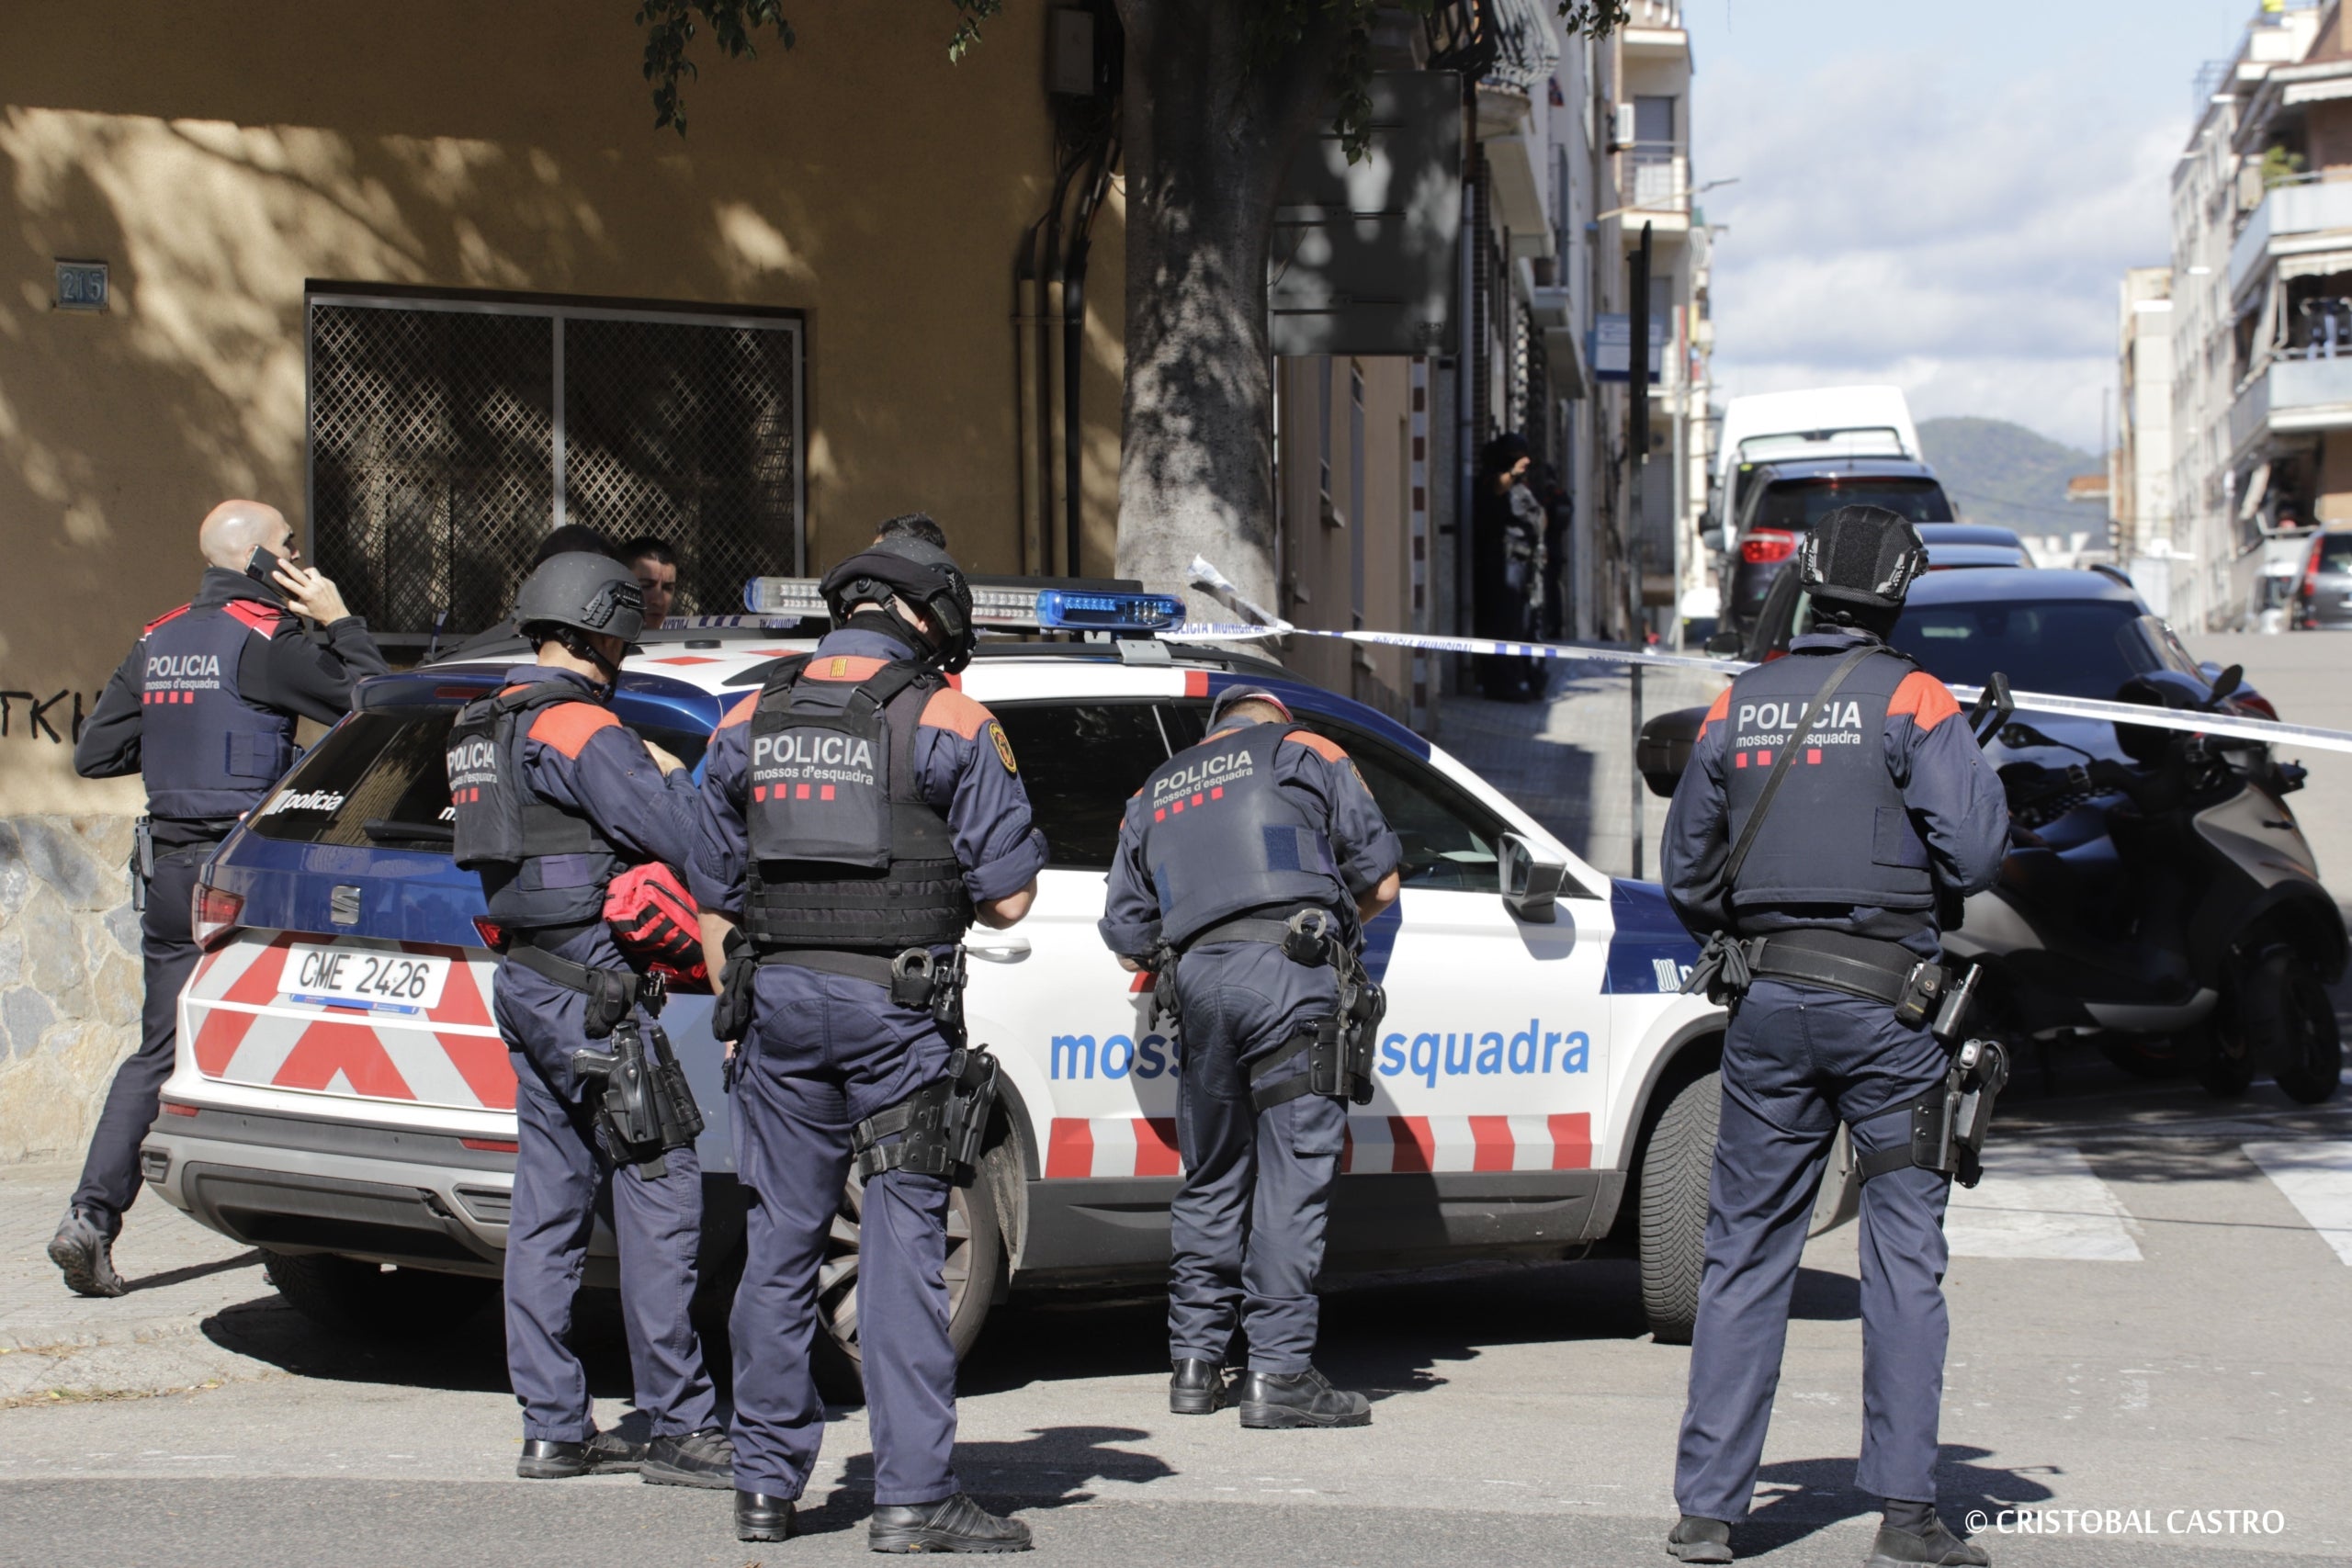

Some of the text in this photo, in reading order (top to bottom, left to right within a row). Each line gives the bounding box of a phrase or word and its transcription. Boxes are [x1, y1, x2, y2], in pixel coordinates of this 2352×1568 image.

[146, 655, 220, 678] POLICIA
[1737, 701, 1862, 732] POLICIA
[753, 735, 873, 770] POLICIA
[1736, 730, 1861, 749] mossos squadra
[447, 742, 496, 778] POLICIA
[753, 765, 874, 785] mossos d'esquadra
[1154, 750, 1252, 797] POLICIA
[279, 790, 345, 813] policia
[1153, 767, 1253, 808] mossos d'esquadra
[300, 952, 430, 999] CME 2426
